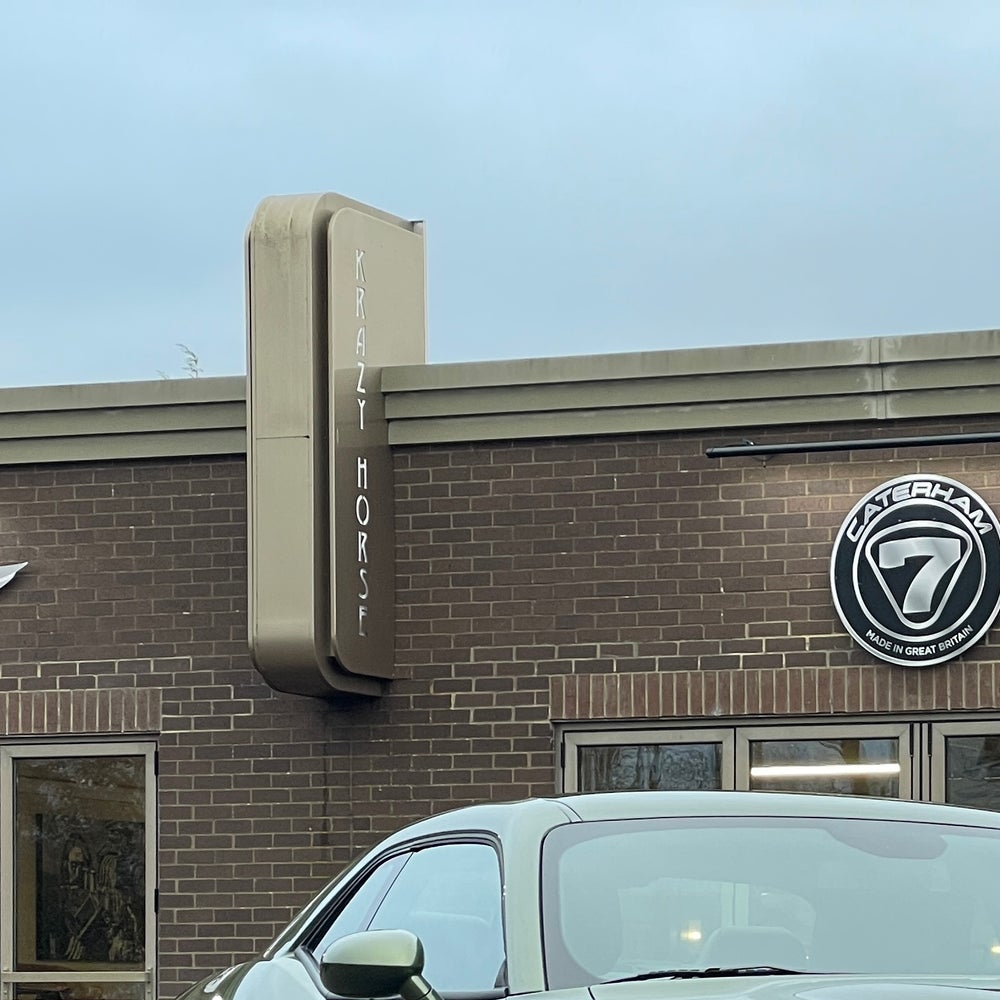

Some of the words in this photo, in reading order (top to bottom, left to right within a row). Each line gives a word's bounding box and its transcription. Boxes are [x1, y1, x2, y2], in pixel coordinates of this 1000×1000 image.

[355, 249, 367, 430] KRAZY
[356, 457, 369, 637] HORSE
[846, 482, 993, 542] CATERHAM
[879, 537, 961, 614] 7
[865, 629, 892, 651] MADE
[892, 643, 904, 654] IN
[905, 645, 938, 656] GREAT
[939, 625, 974, 652] BRITAIN
